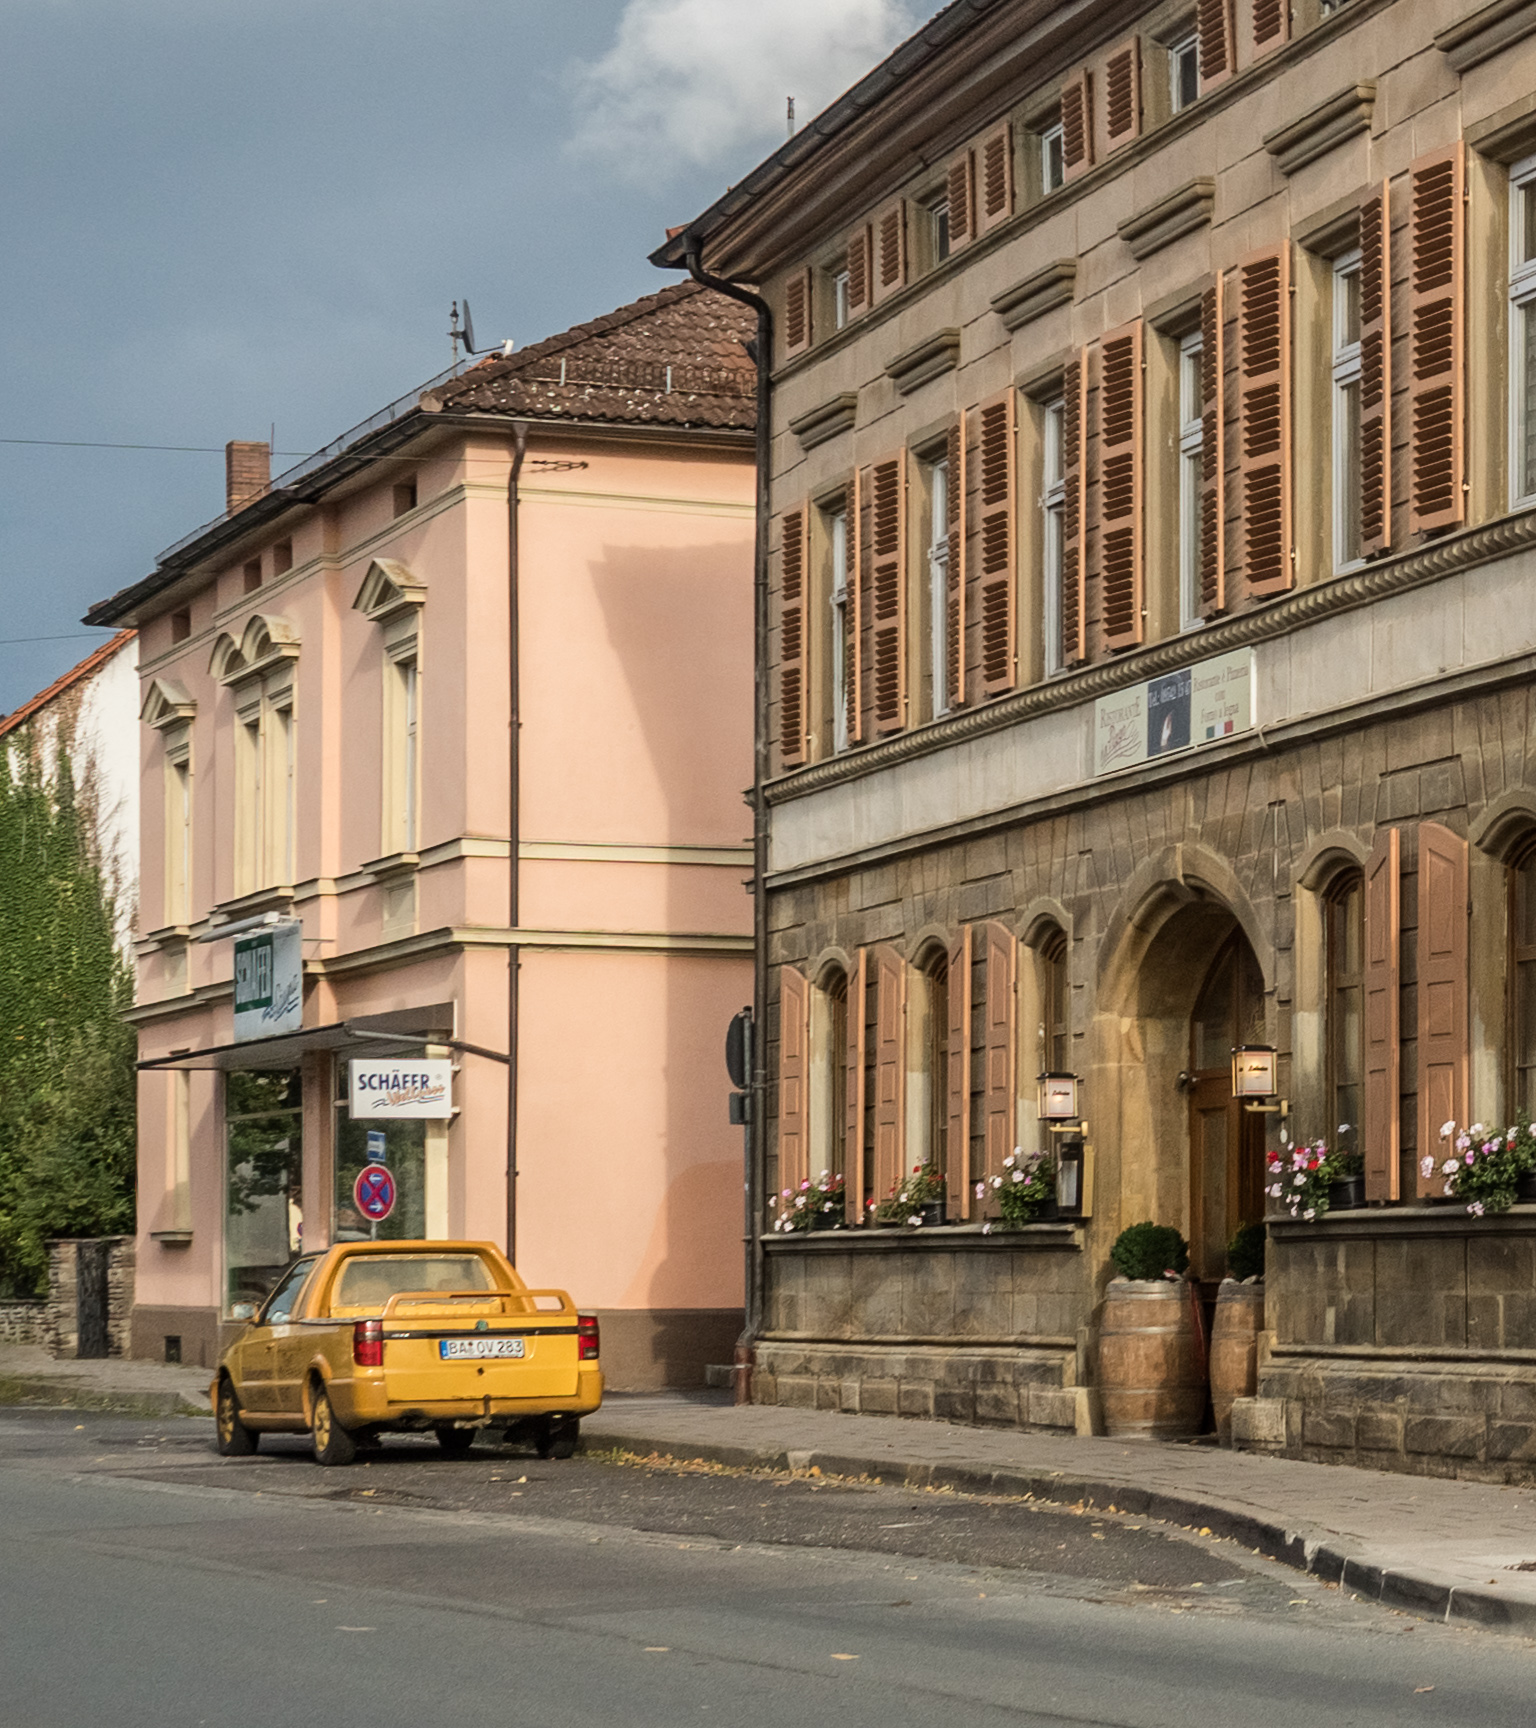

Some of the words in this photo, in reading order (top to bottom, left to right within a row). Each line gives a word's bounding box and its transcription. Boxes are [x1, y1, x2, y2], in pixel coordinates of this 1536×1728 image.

[358, 1069, 430, 1090] SCHÄFER
[448, 1342, 467, 1354] BA
[477, 1341, 494, 1353] OV
[497, 1340, 522, 1353] 283
